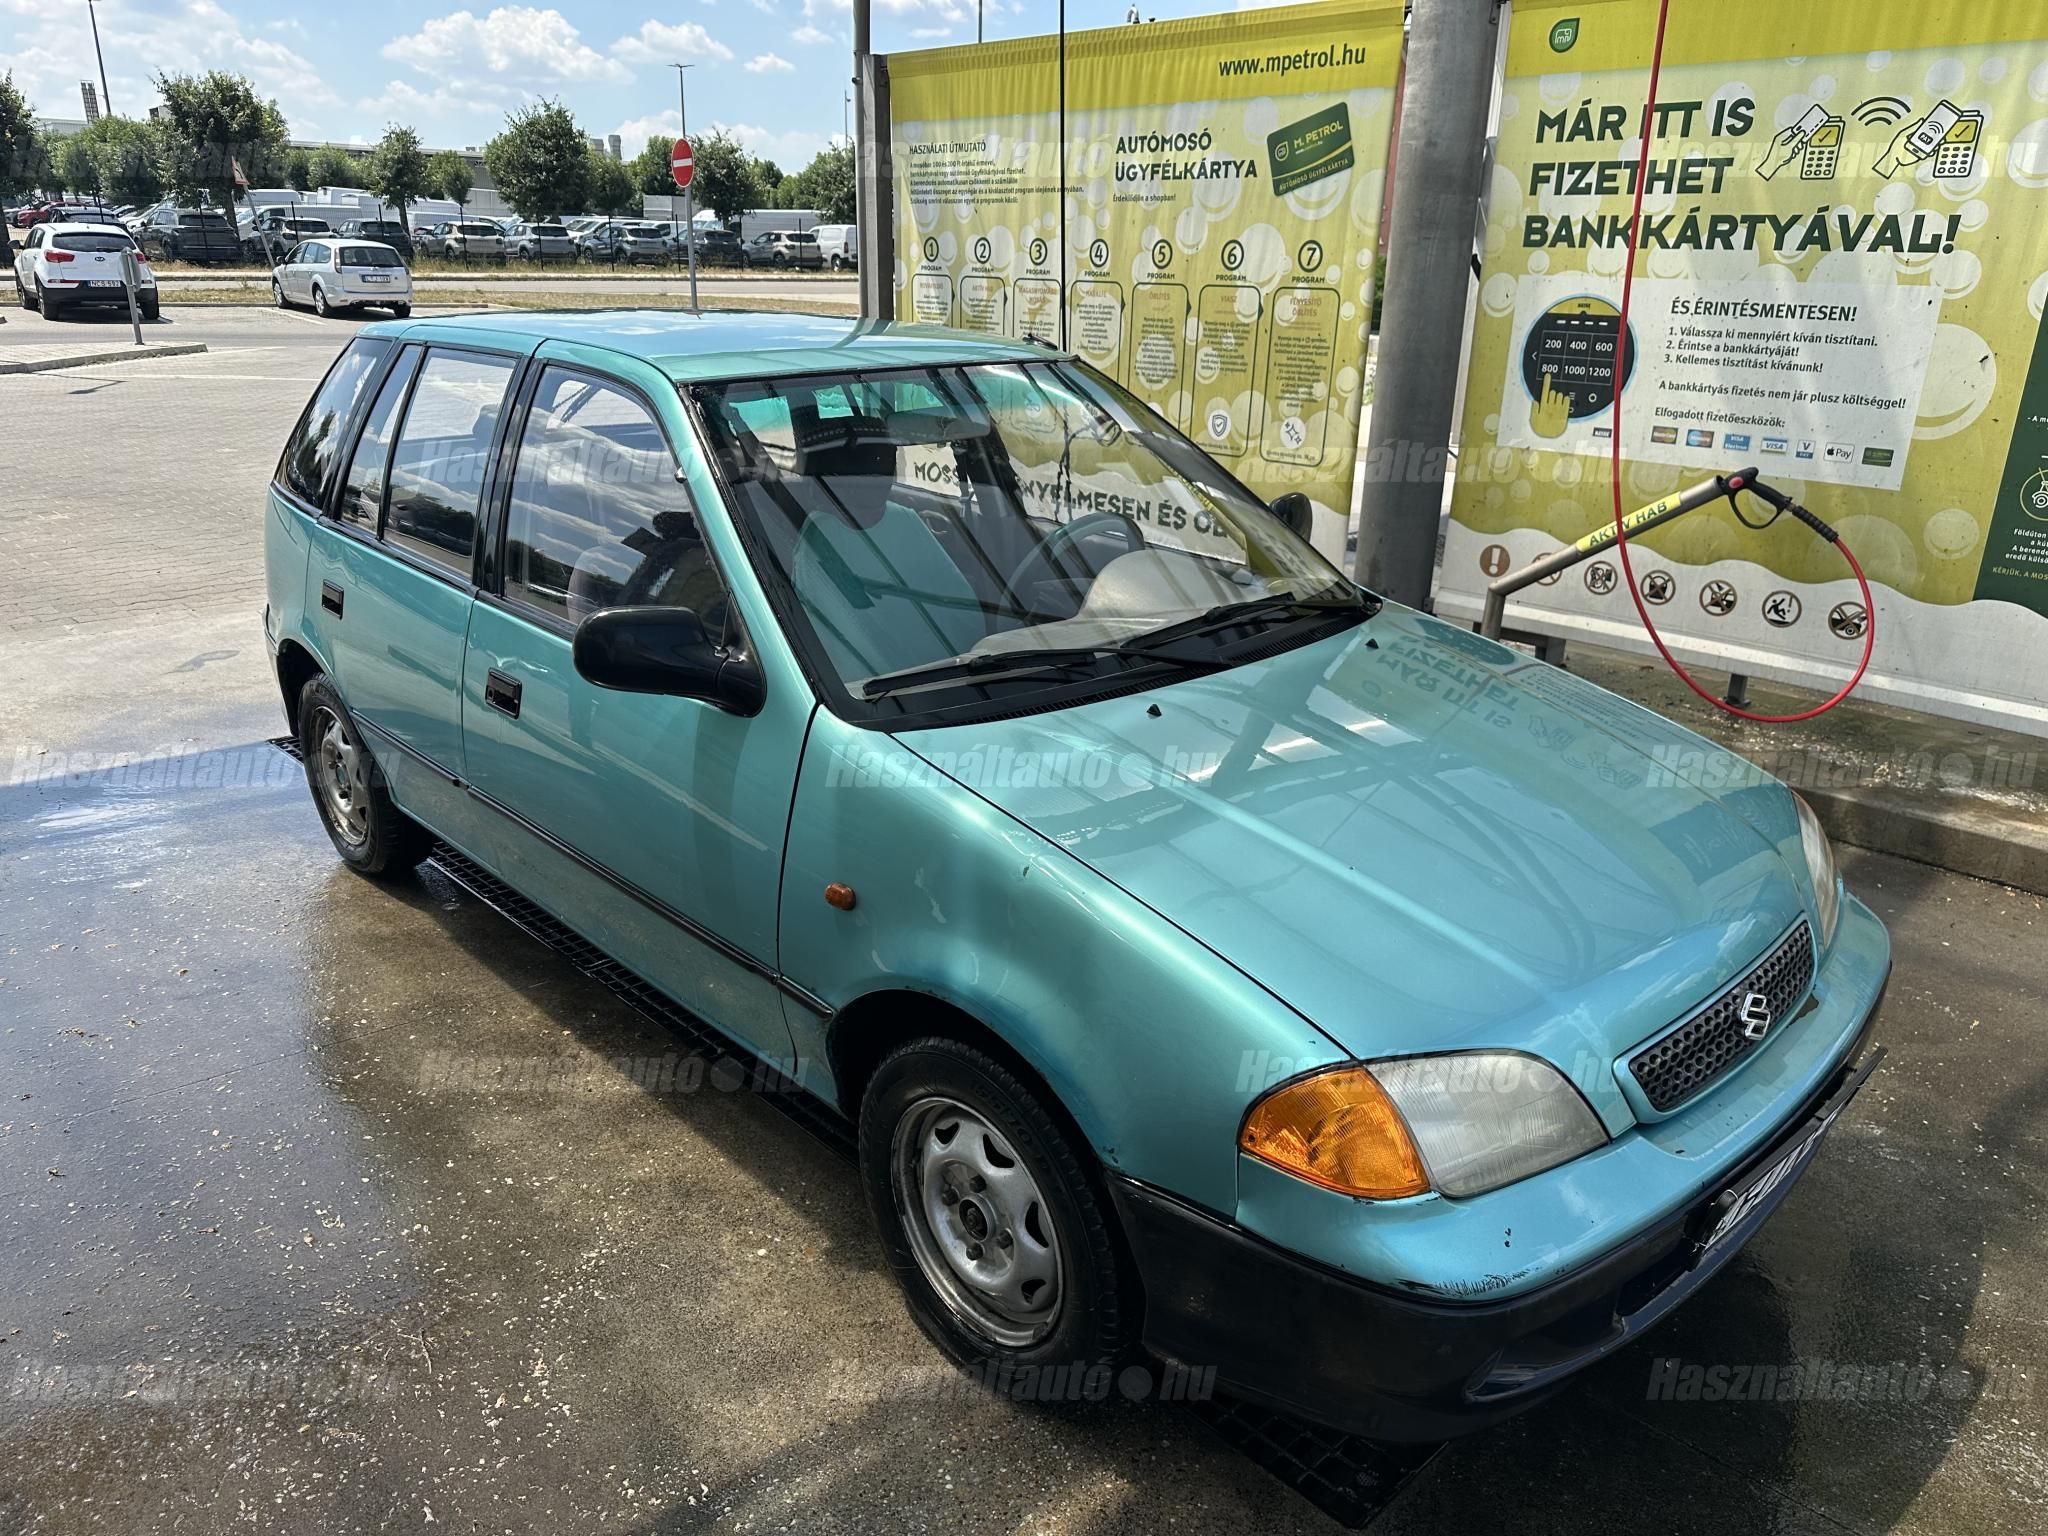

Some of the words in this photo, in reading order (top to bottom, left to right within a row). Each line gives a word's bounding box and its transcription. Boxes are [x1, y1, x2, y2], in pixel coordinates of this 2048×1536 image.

[1219, 43, 1366, 77] www.mpetrol.hu
[1536, 99, 1627, 143] MÁR
[1710, 97, 1757, 137] IS
[1116, 128, 1212, 154] AUTÓMOSÓ
[1306, 121, 1344, 144] PETROL
[909, 142, 948, 155] HASZNÁLATI
[949, 140, 986, 154] ÚTMUTATÓ
[1115, 158, 1258, 182] ÜGYFÉLKÁRTYA
[1529, 157, 1734, 196] FIZETHET
[1279, 175, 1308, 191] AUTÓMOSÓ
[1522, 204, 1962, 254] BANKKÁRTYÁVAL!
[921, 264, 943, 272] PROGRAM
[971, 266, 995, 274] PROGRAM
[1025, 268, 1051, 276] PROGRAM
[1084, 270, 1111, 278] PROGRAM
[1147, 272, 1175, 280] PROGRAM
[1215, 274, 1247, 282] PROGRAM
[1291, 275, 1326, 284] PROGRAM
[1671, 297, 1690, 315] ÉS
[1694, 297, 1857, 322] ÉRINTÉSMENTESEN!
[1545, 339, 1562, 349] 200
[1569, 341, 1587, 350] 400
[1595, 342, 1613, 352] 600
[1669, 327, 1678, 336] 1.
[1680, 326, 1722, 339] Válassza
[1725, 329, 1735, 339] ki
[1737, 329, 1790, 344] mennyiért
[1793, 331, 1822, 344] kíván
[1825, 333, 1878, 347] tisztítani.
[1666, 340, 1675, 349] 2.
[1678, 338, 1712, 352] Érintse
[1714, 344, 1720, 352] a
[1723, 343, 1799, 358] bankkártyáját!
[1541, 363, 1558, 373] 800
[1564, 365, 1585, 375] 1000
[1589, 367, 1611, 377] 1200
[1664, 353, 1673, 363] 3.
[1675, 354, 1720, 367] Kellemes
[1722, 356, 1768, 369] tisztítást
[1770, 359, 1823, 373] kívánunk!
[1659, 380, 1667, 389] A
[1668, 380, 1729, 396] bankkártyás
[1731, 384, 1766, 397] fizetés
[1768, 389, 1790, 399] nem
[1792, 389, 1808, 403] jár
[1810, 391, 1839, 405] plusz
[1842, 394, 1906, 410] költséggel!
[1655, 407, 1704, 423] Elfogadott
[1706, 411, 1786, 429] fizetőeszközök:
[1765, 442, 1784, 450] VISA
[1802, 442, 1811, 451] V
[1835, 448, 1851, 460] Pay
[1158, 499, 1187, 530] ÉS
[1589, 518, 1631, 547] AKTV
[1635, 501, 1667, 524] HAB
